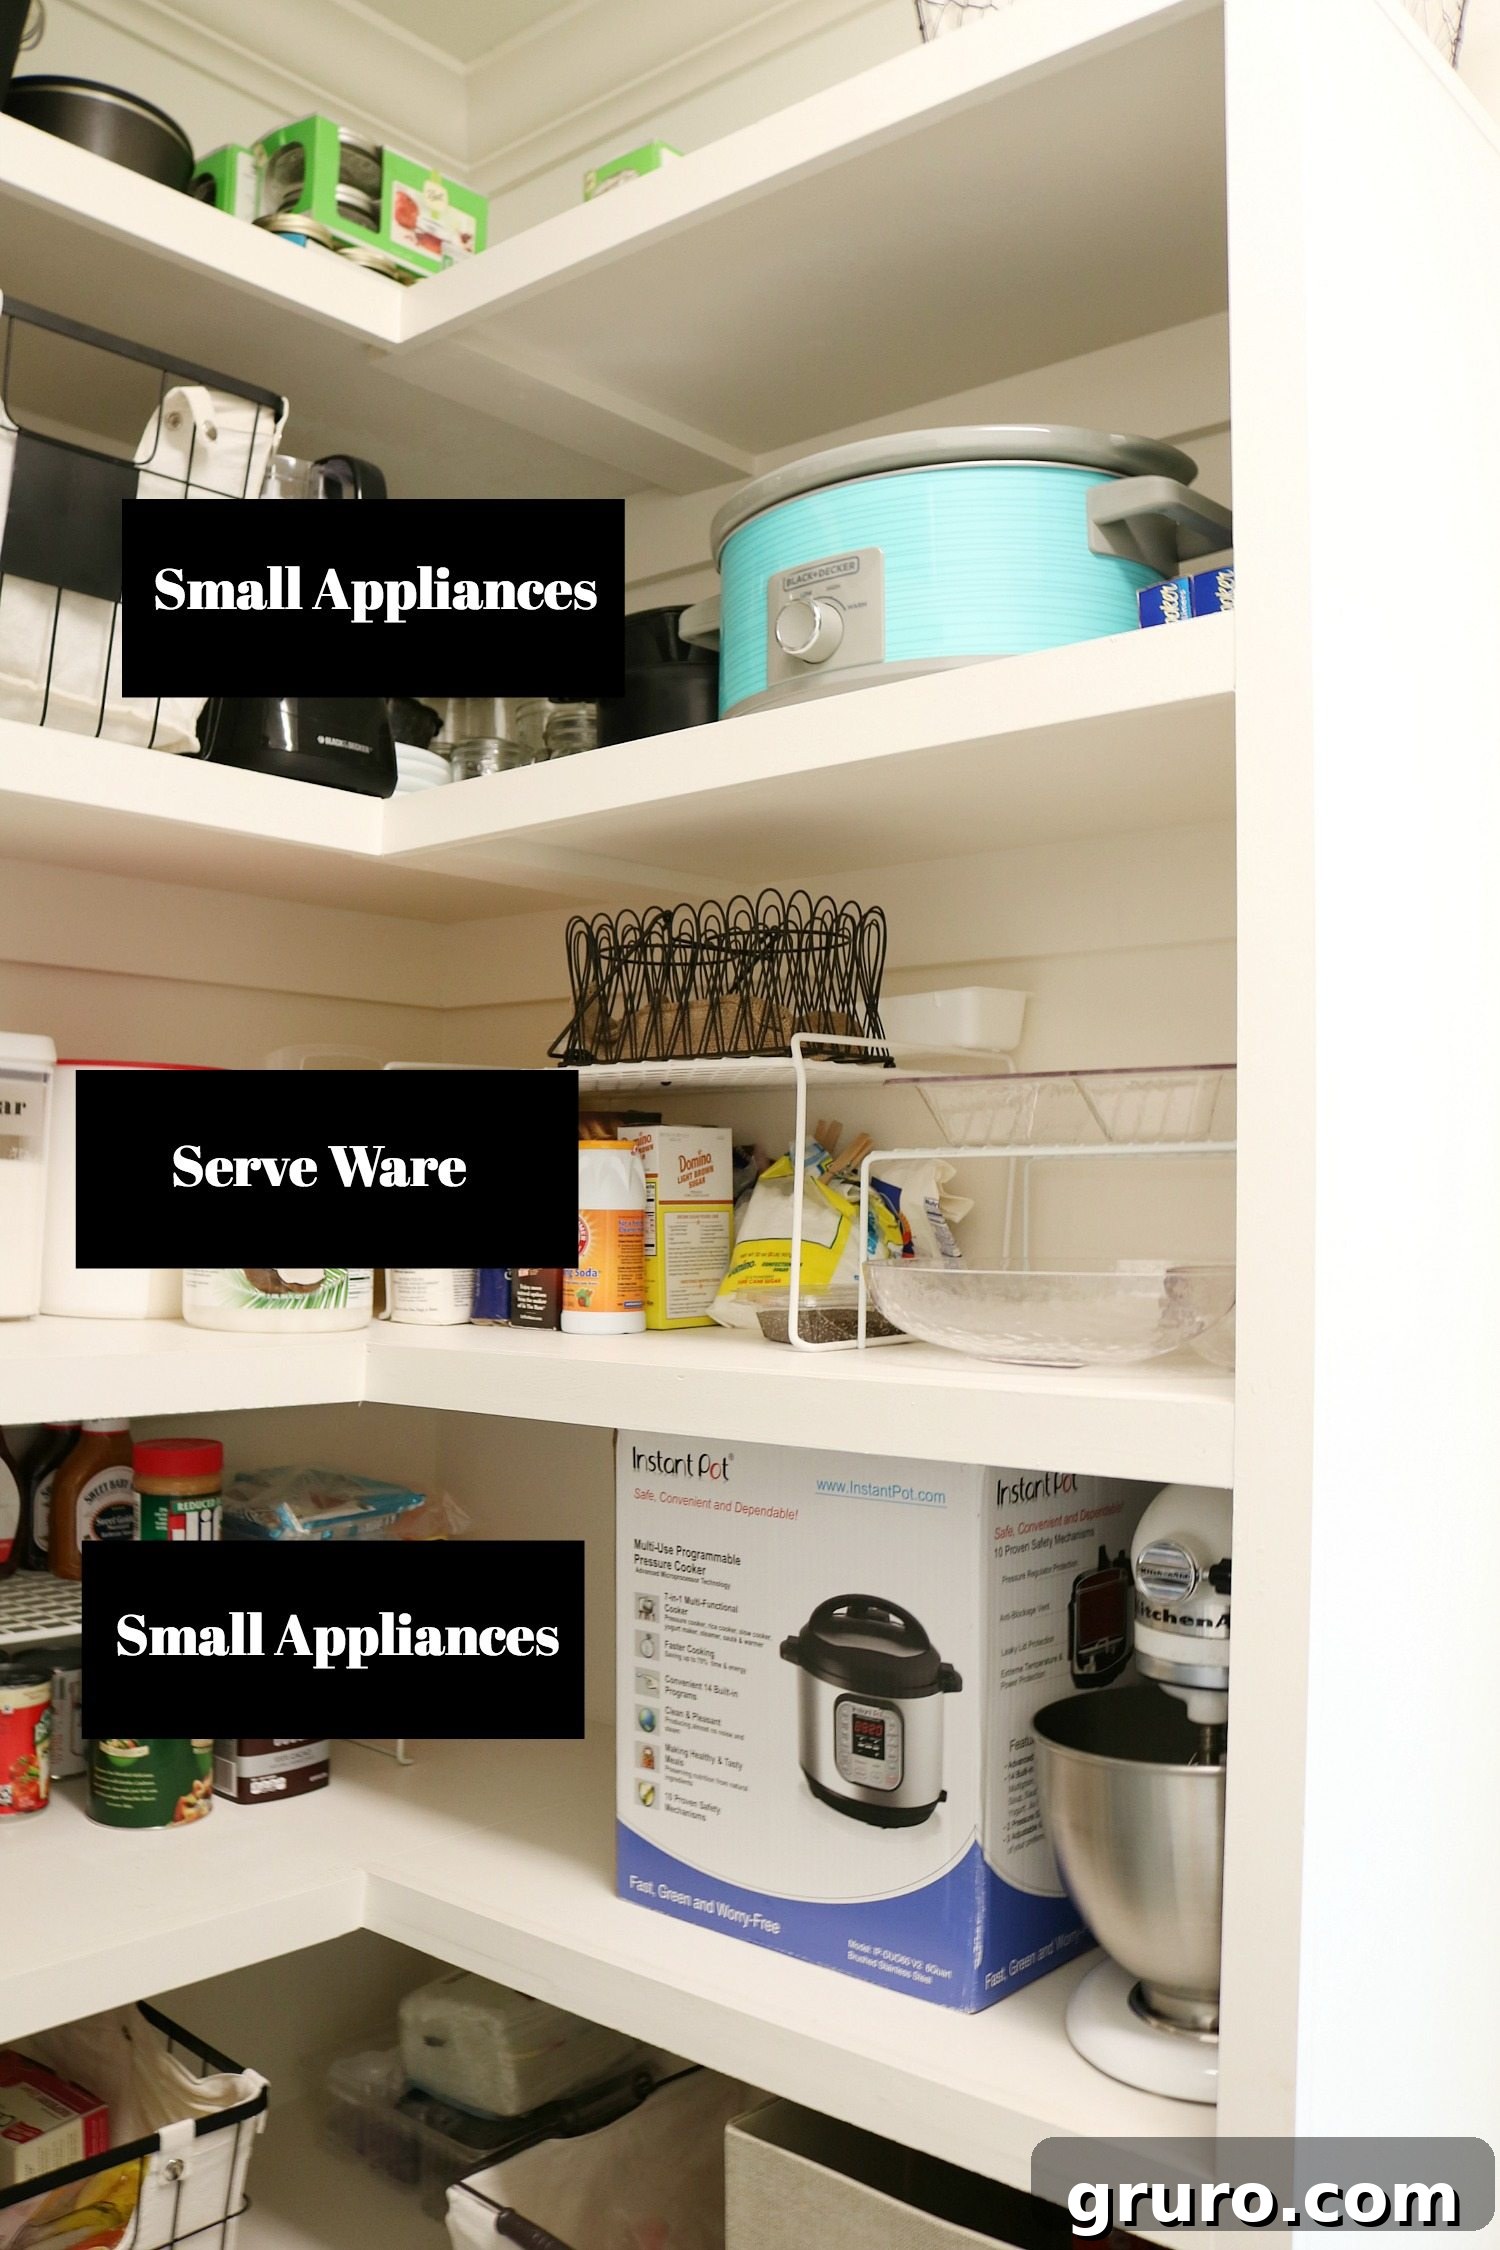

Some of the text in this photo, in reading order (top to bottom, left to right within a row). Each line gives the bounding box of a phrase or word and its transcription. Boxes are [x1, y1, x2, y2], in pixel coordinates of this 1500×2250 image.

[786, 561, 856, 588] BLACK+DECKER
[679, 1152, 712, 1173] Domino
[677, 1171, 693, 1185] LIGHT
[575, 1267, 598, 1278] Soda
[632, 1446, 694, 1478] Instant
[816, 1479, 946, 1504] www.InstantPot.com
[996, 1472, 1050, 1507] Instant
[633, 1487, 799, 1521] Safe, Convenient and Dependable!
[993, 1526, 1015, 1541] Safe,
[1017, 1514, 1063, 1536] Convenient
[1063, 1511, 1079, 1526] and
[634, 1538, 742, 1566] Multi-Use Programmable
[994, 1527, 1095, 1559] 10 Proven Safety Mechanisms
[634, 1553, 707, 1576] Pressure Cooker
[664, 1603, 689, 1616] Cooker
[684, 1595, 739, 1613] Multi-Functional
[664, 1640, 716, 1660] Faster Cooking
[664, 1674, 702, 1690] Convenient
[704, 1683, 712, 1692] 14
[664, 1686, 697, 1700] Programs
[664, 1706, 684, 1717] Clean
[664, 1743, 689, 1758] Making
[690, 1749, 716, 1765] Healthy
[724, 1757, 743, 1772] Tasty
[664, 1803, 707, 1821] Mechanisms
[673, 1793, 697, 1807] Proven
[699, 1800, 722, 1816] Safety
[629, 1874, 781, 1935] Fast, Green and Worry-Free
[1008, 1951, 1036, 1977] Green
[1037, 1940, 1054, 1962] and
